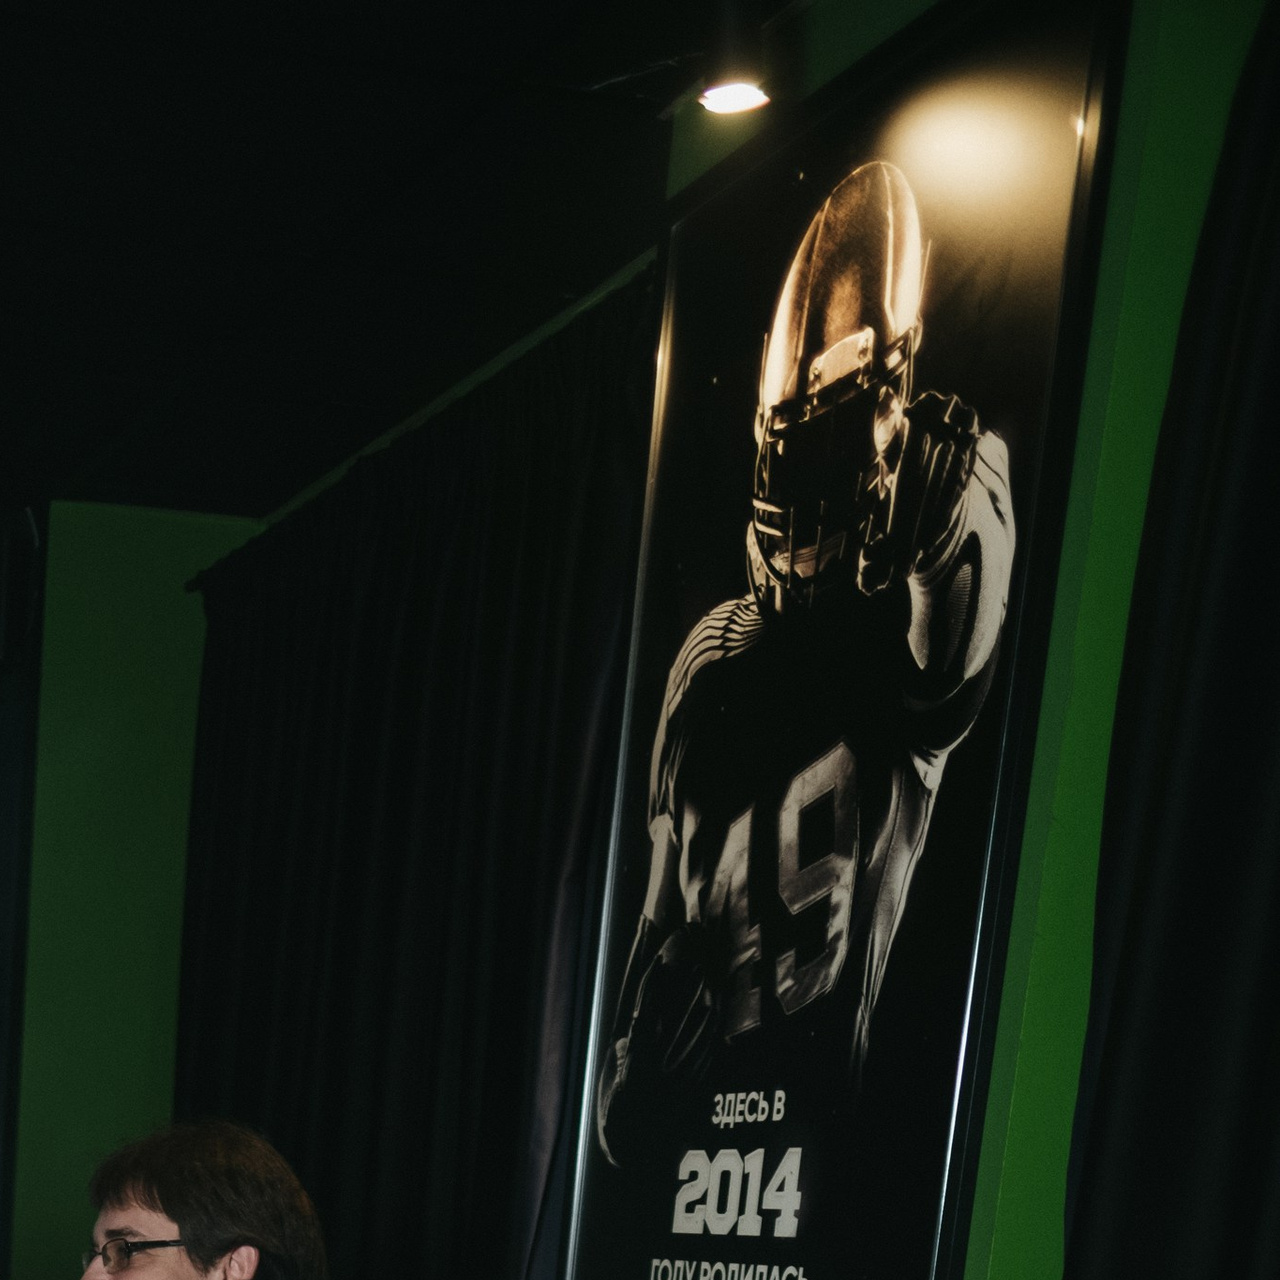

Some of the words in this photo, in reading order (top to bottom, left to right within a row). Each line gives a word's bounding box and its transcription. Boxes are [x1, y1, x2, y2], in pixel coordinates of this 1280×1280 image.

[712, 1092, 769, 1128] ЗДЕСЬ
[773, 1090, 786, 1122] В
[672, 1147, 802, 1238] 2014
